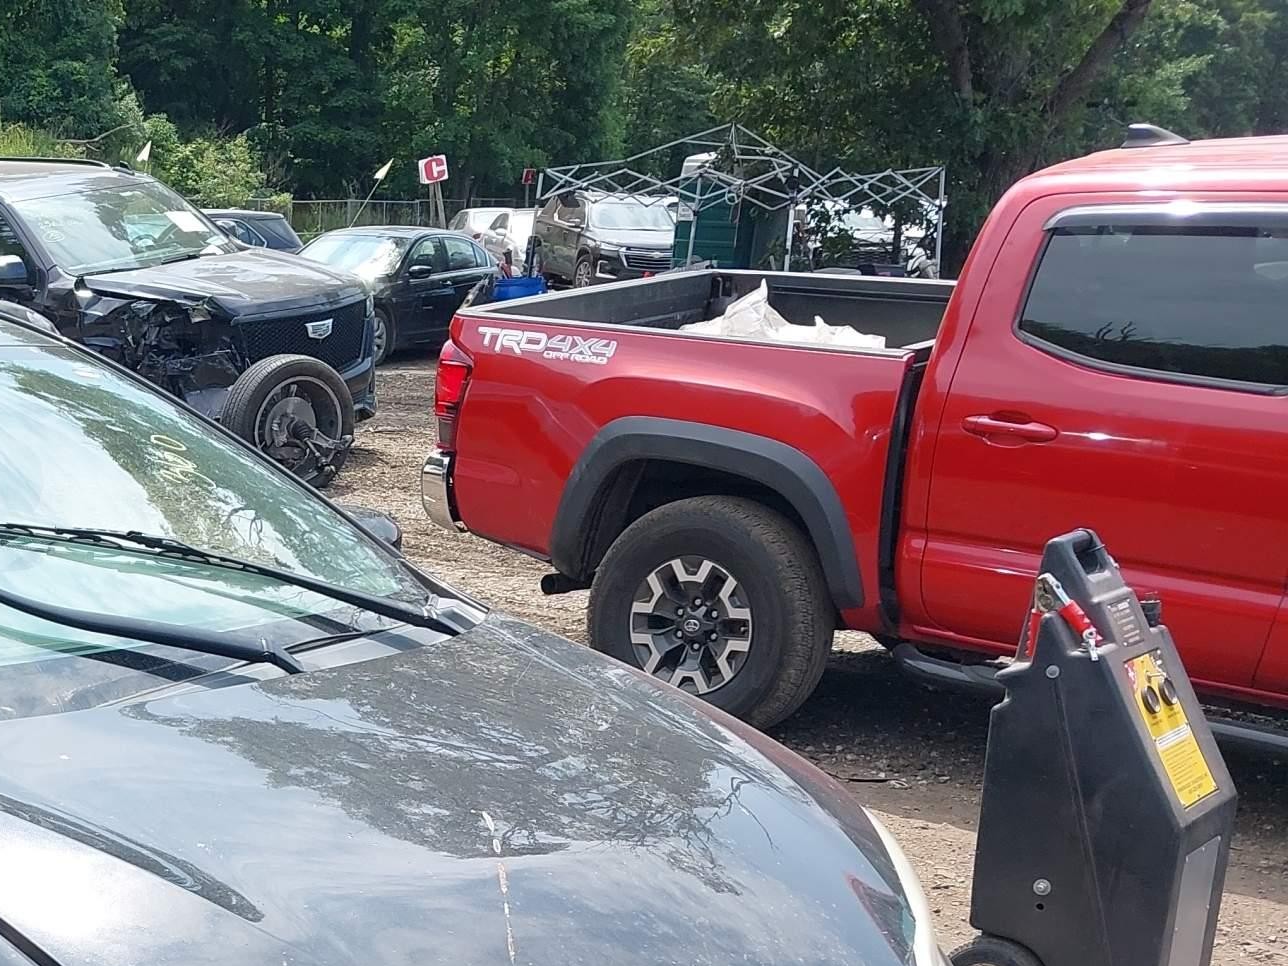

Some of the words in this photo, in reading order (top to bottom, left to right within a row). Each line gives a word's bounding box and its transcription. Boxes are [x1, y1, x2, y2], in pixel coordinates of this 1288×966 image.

[424, 157, 446, 181] C
[477, 326, 548, 355] TRD
[542, 350, 570, 361] OFF
[570, 353, 608, 365] ROAD
